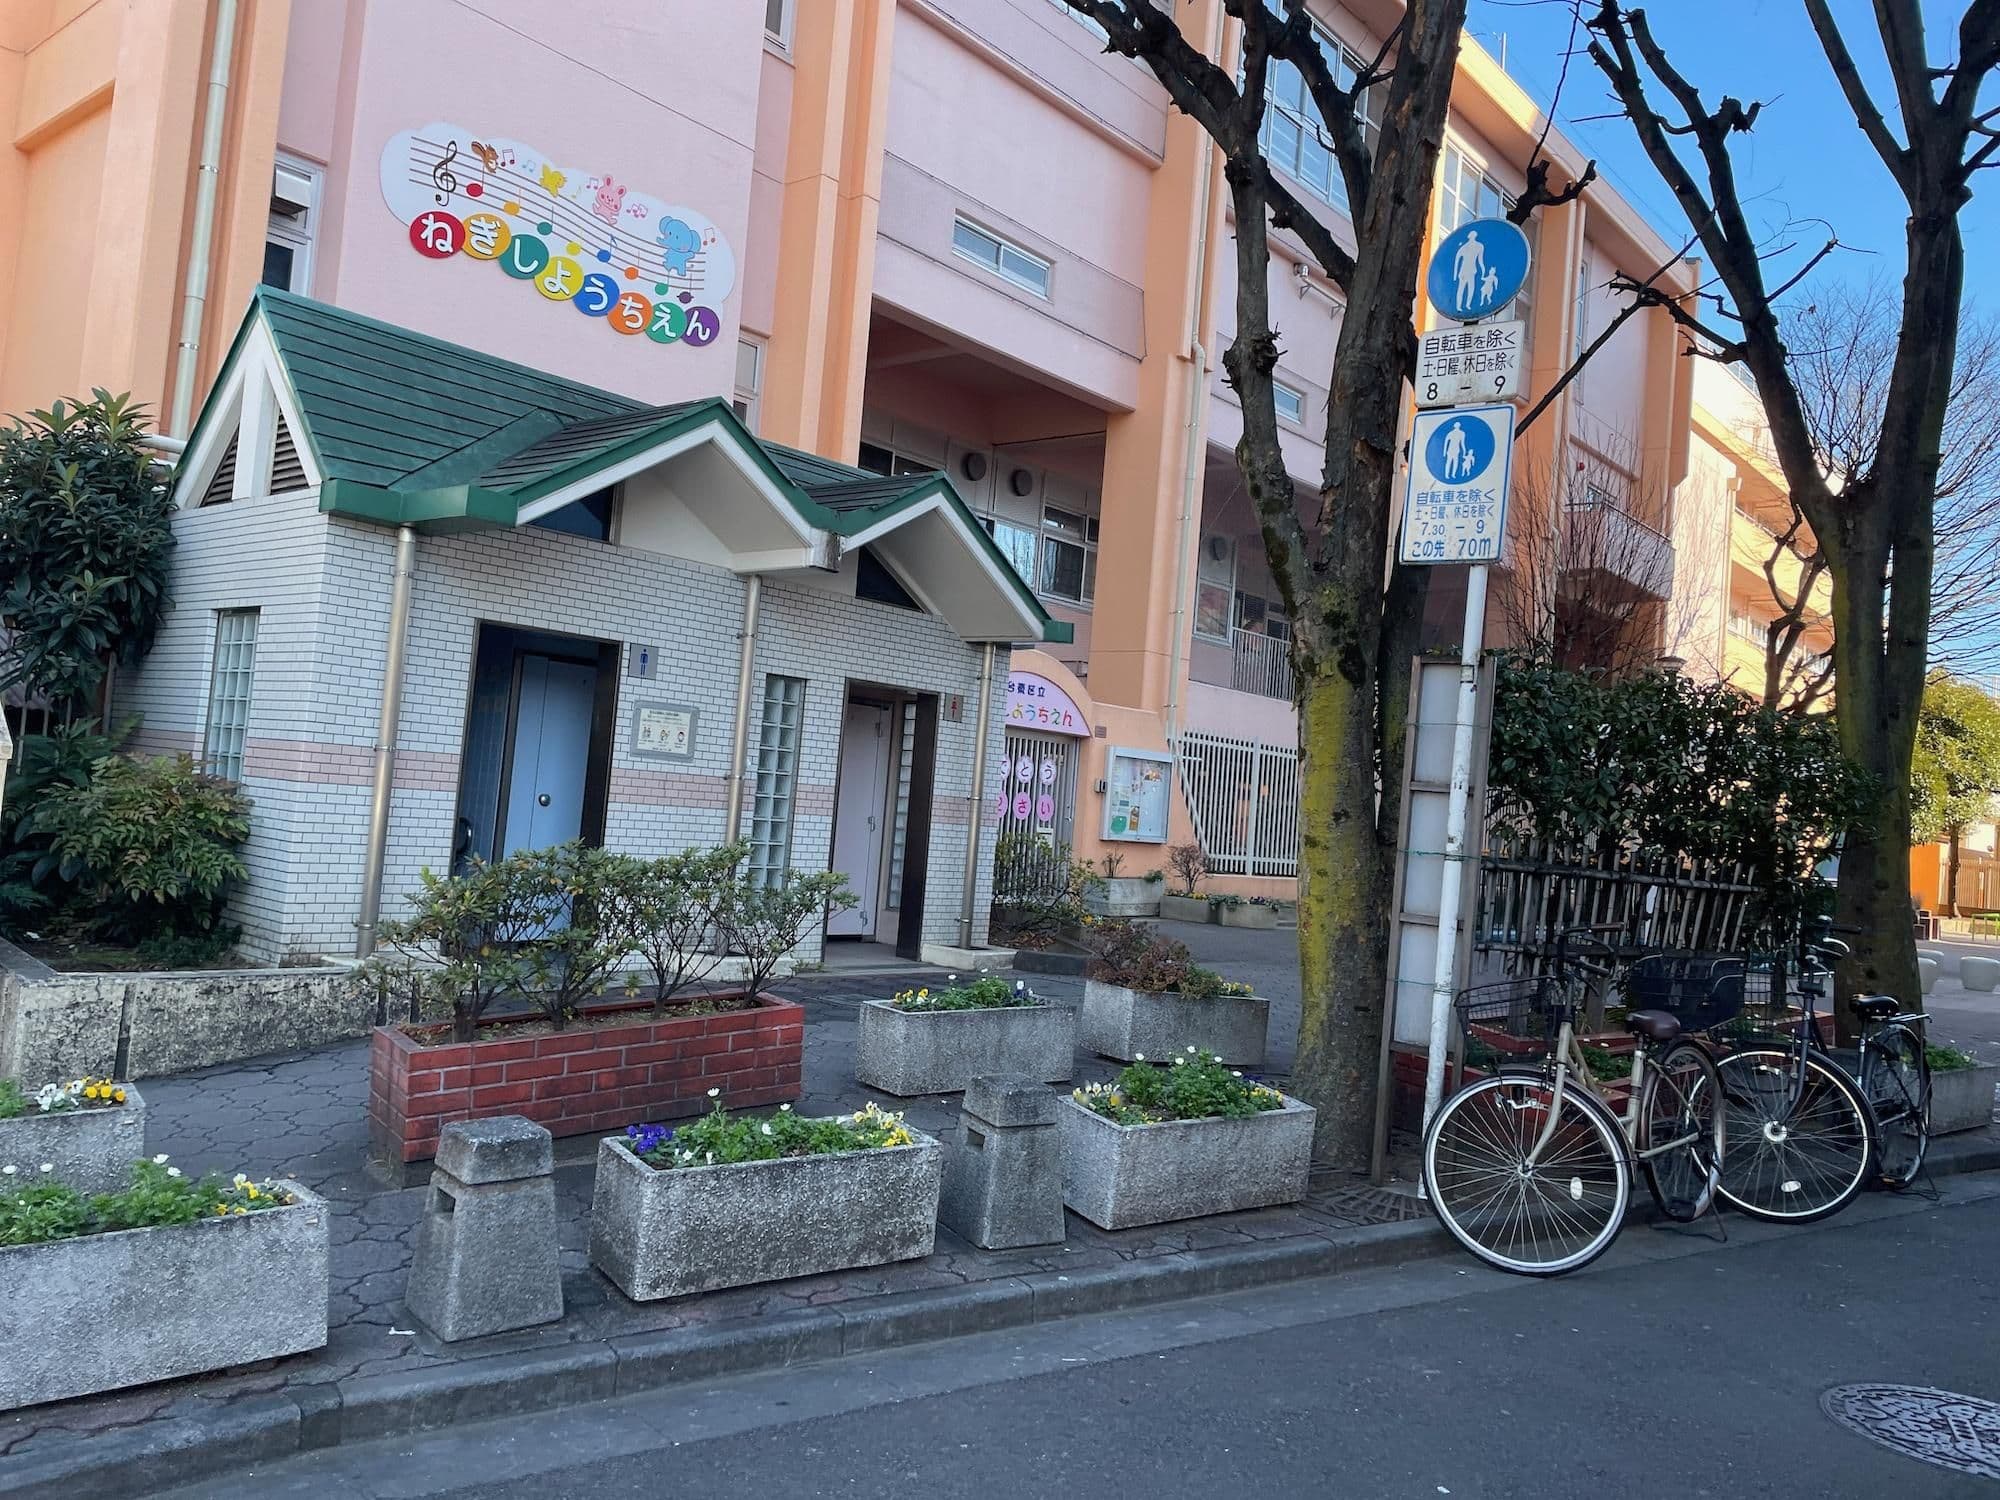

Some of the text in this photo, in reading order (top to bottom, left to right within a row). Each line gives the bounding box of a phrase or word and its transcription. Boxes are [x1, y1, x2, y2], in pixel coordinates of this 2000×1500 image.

[420, 210, 711, 341] ねぎしようちえん
[1425, 329, 1517, 355] 自転車を除く
[1427, 383, 1438, 400] 8
[1495, 376, 1506, 394] 9
[1416, 488, 1496, 505] 自転車を除く
[1476, 519, 1485, 534] 9
[1411, 537, 1492, 558] この先 70m
